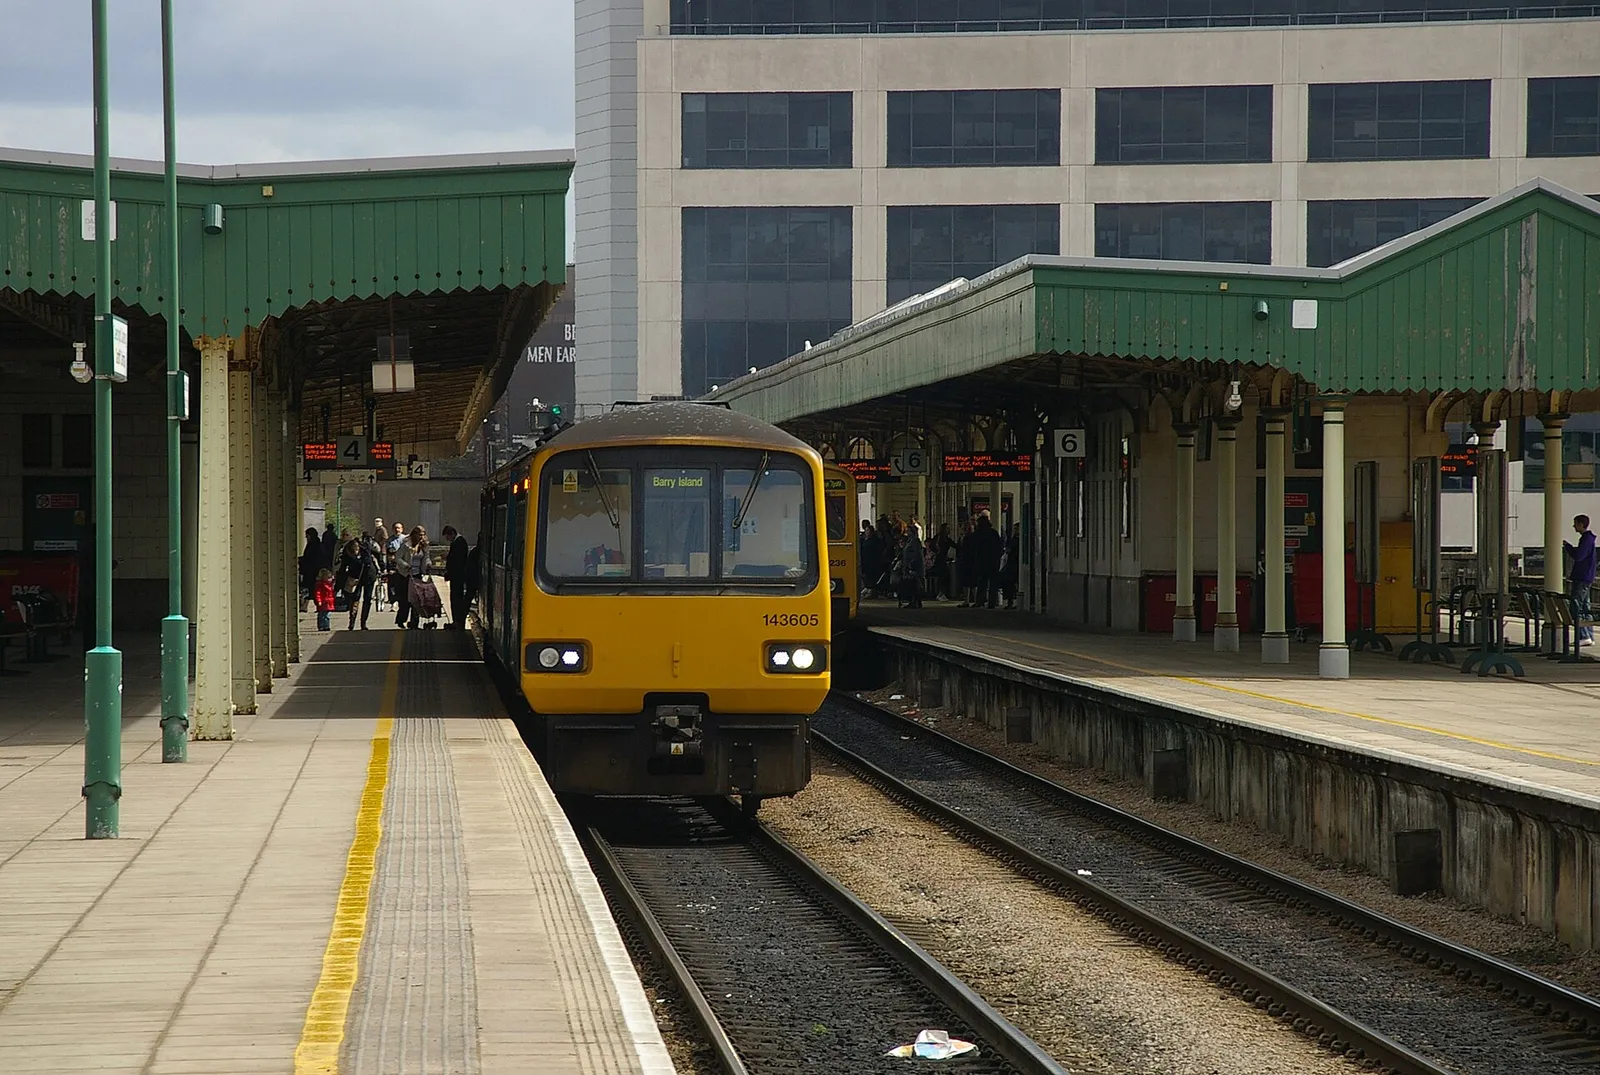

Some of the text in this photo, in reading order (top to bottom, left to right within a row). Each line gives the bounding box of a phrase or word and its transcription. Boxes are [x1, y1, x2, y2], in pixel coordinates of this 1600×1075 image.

[527, 346, 553, 363] MEN
[343, 440, 361, 461] 4
[1061, 433, 1078, 453] 6
[909, 452, 921, 468] 6
[653, 476, 703, 489] Barry Island
[762, 613, 819, 627] 143605
